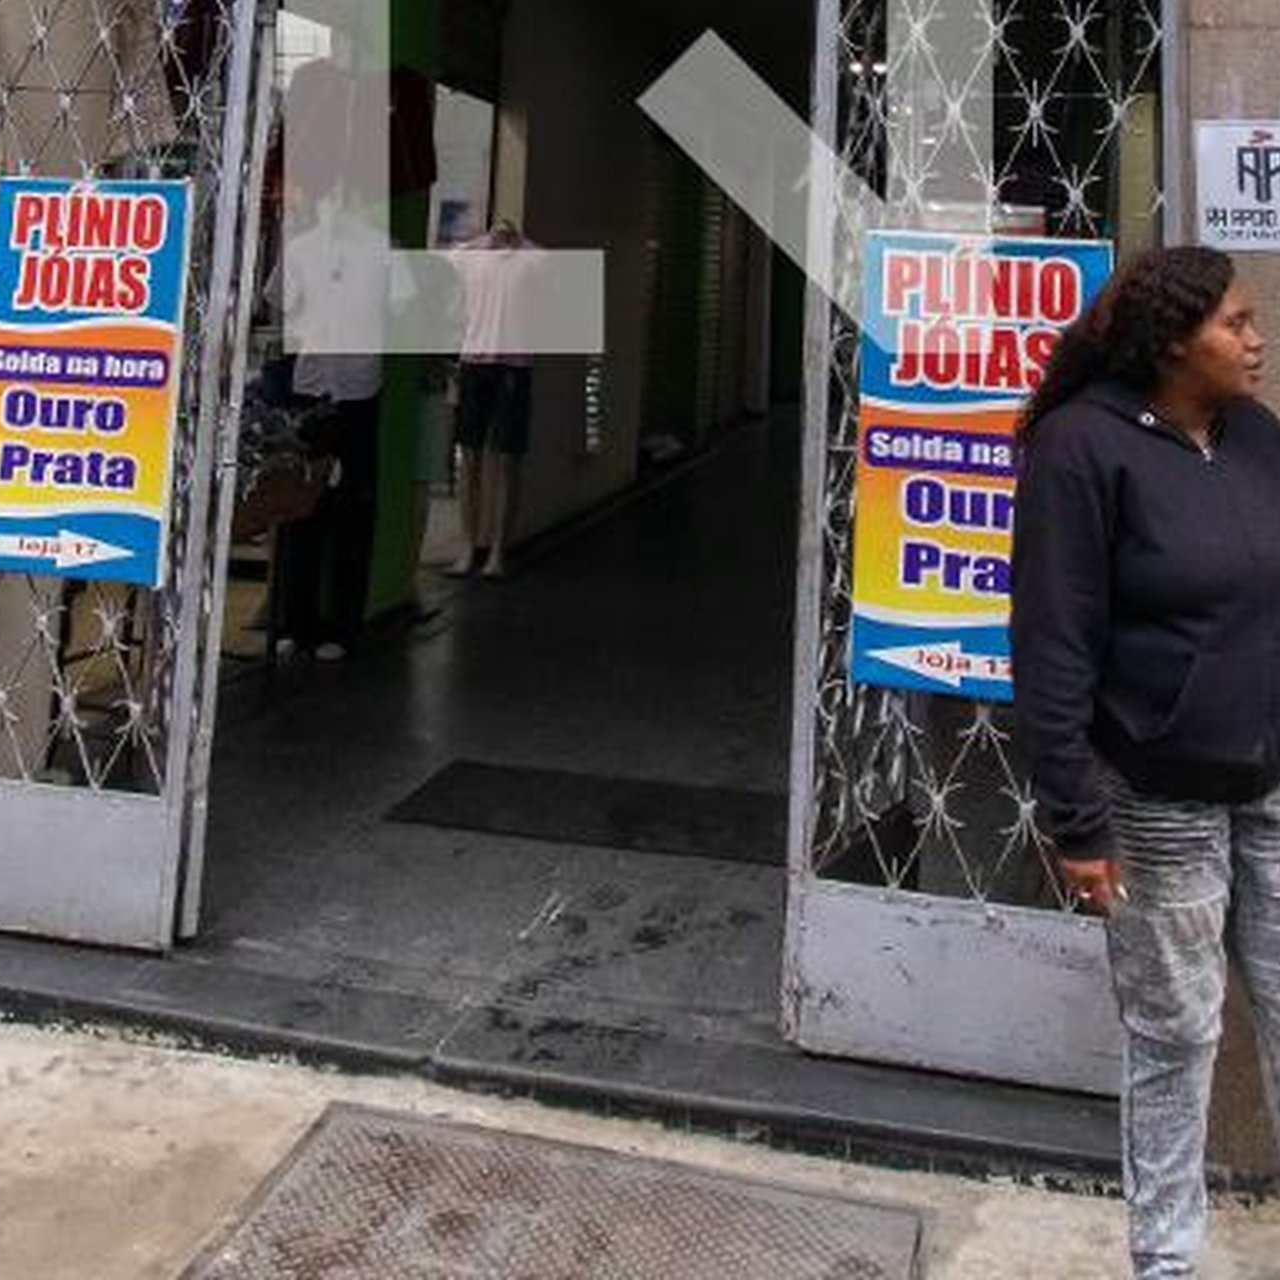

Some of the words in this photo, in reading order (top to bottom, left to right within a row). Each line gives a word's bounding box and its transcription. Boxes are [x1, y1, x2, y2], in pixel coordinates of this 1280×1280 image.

[12, 184, 166, 252] PLÍNIO
[16, 249, 150, 312] JÓIAS
[884, 241, 1081, 323] PLÍNIO
[66, 353, 99, 376] na
[105, 351, 165, 381] hora
[4, 389, 126, 432] Ouro
[0, 444, 136, 489] Prata
[869, 428, 962, 464] Solda
[969, 439, 1011, 467] na
